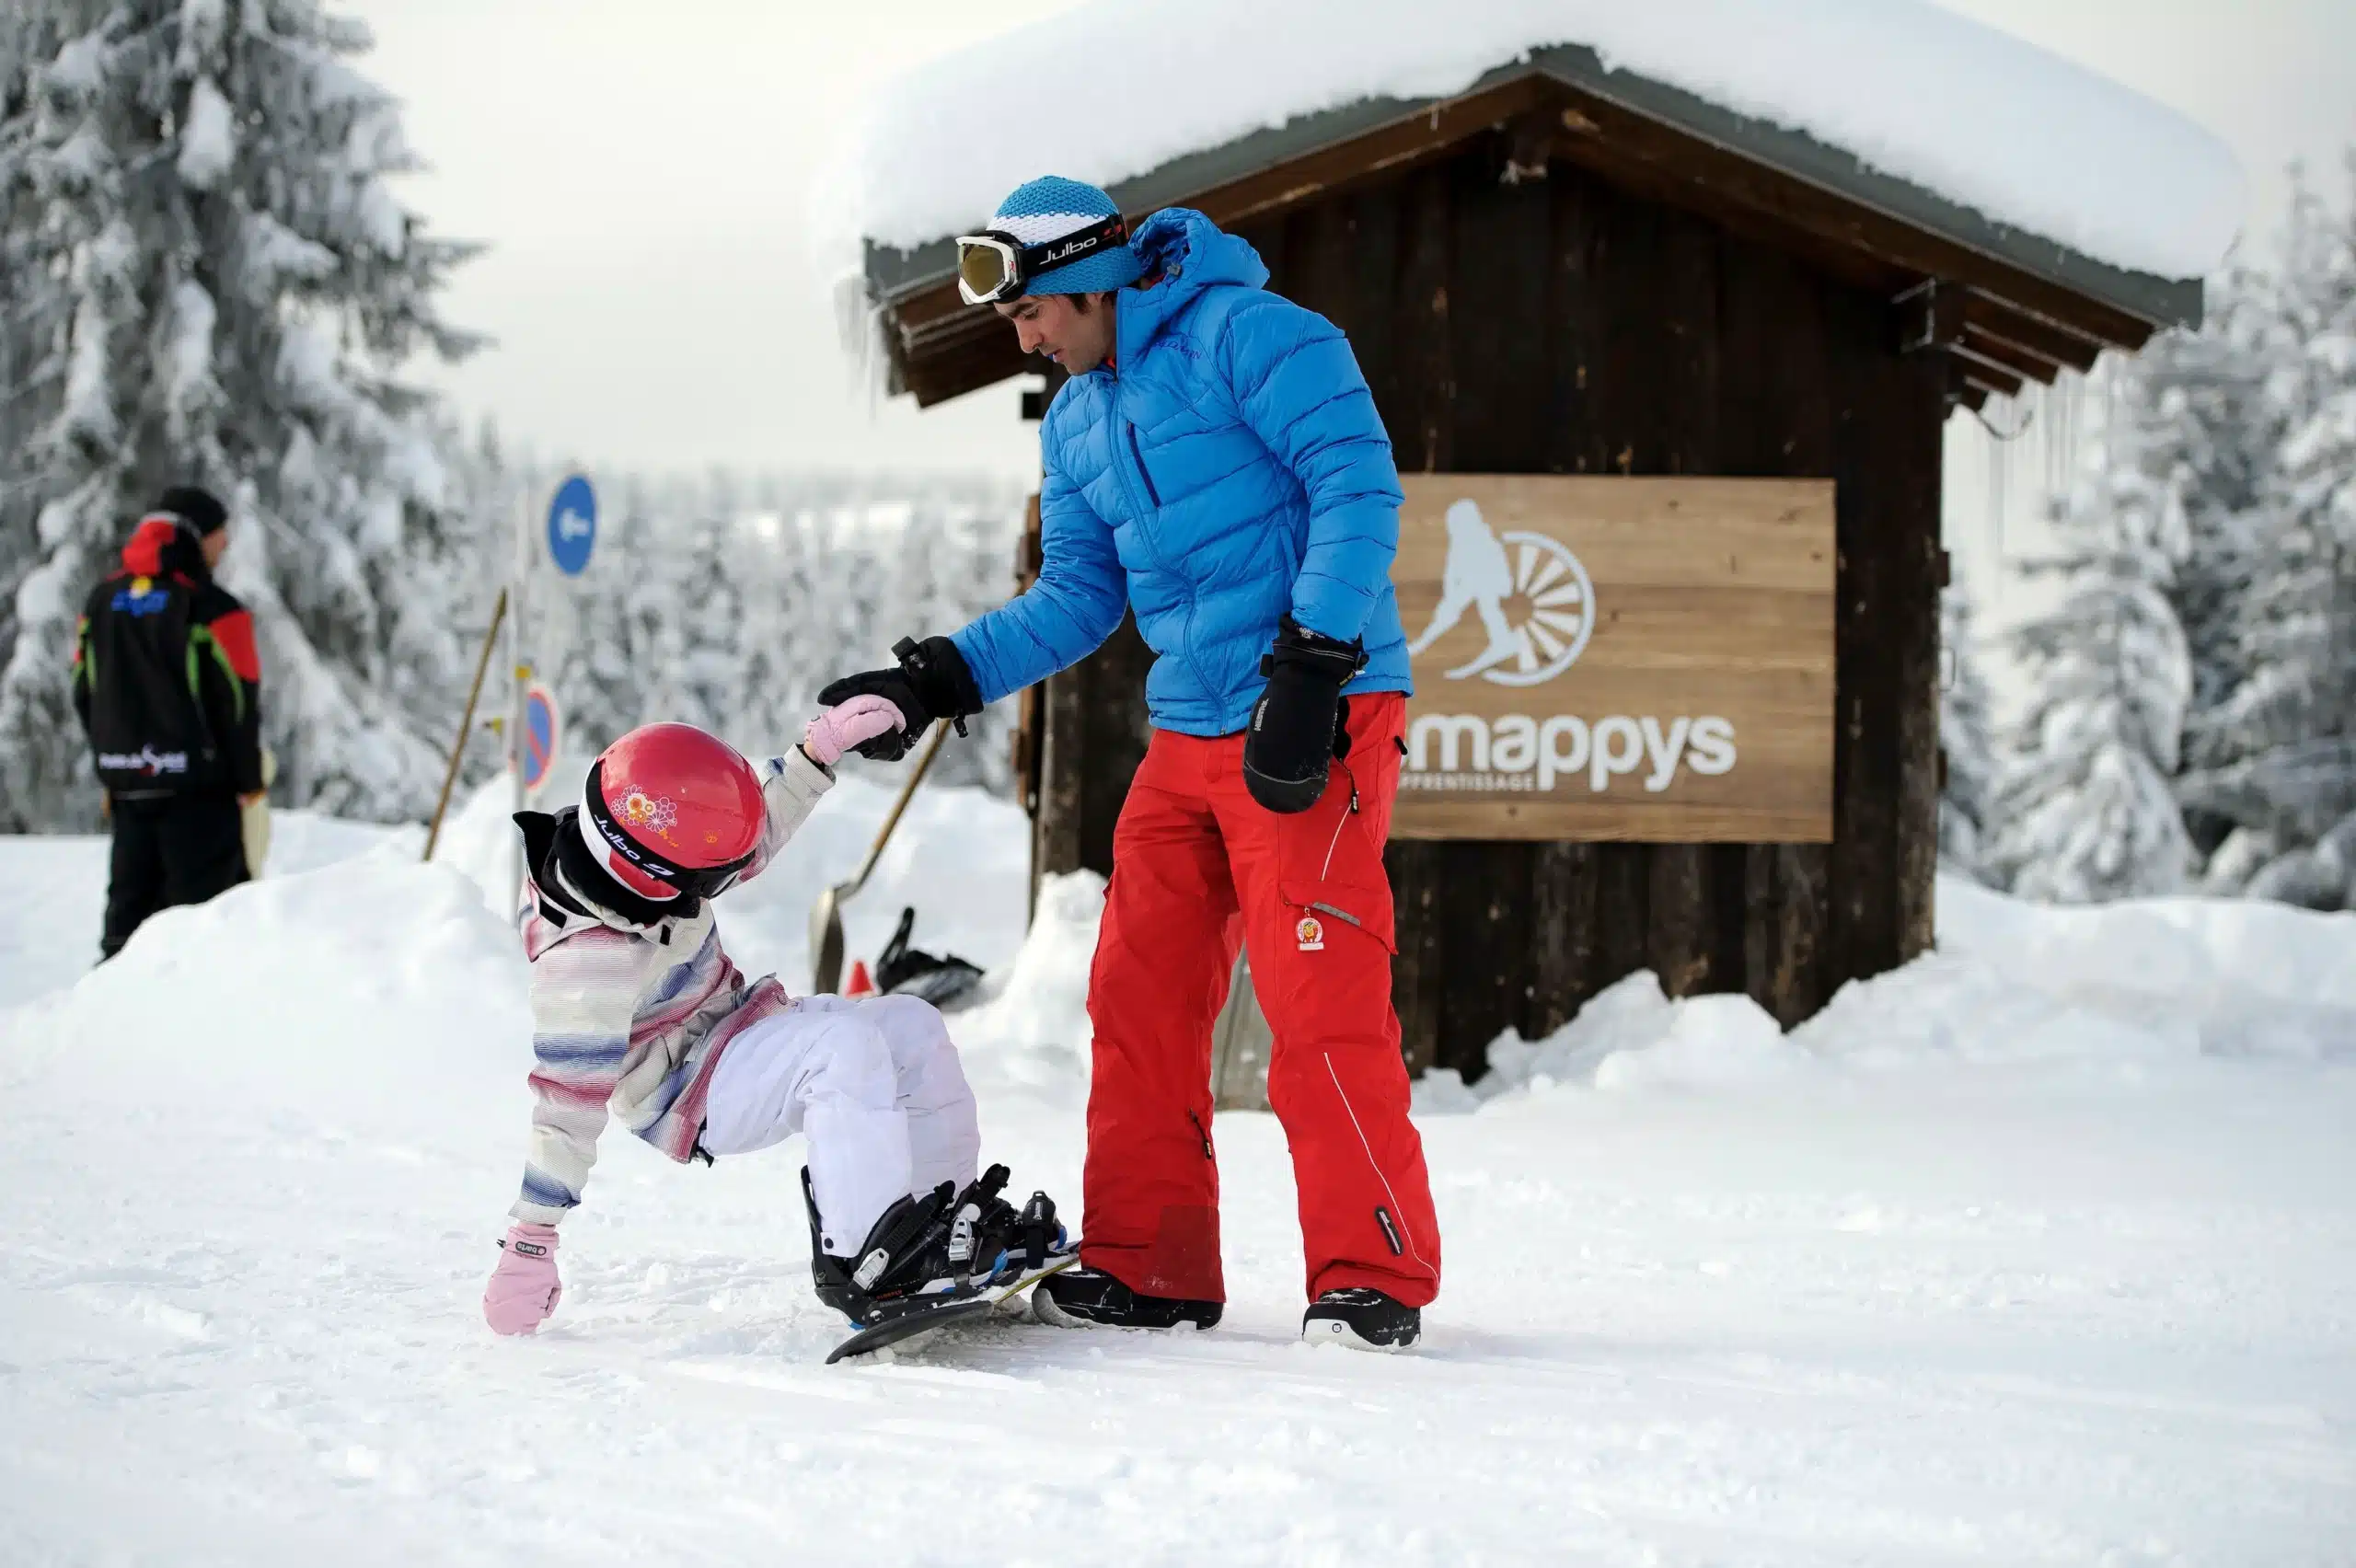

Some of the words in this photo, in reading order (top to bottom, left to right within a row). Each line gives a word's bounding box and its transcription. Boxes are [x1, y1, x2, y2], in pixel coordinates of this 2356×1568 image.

[1039, 236, 1097, 265] Julbo
[1401, 713, 1738, 792] mappys
[1399, 772, 1534, 791] PPRENTISSAGE
[595, 814, 641, 860] Julbo
